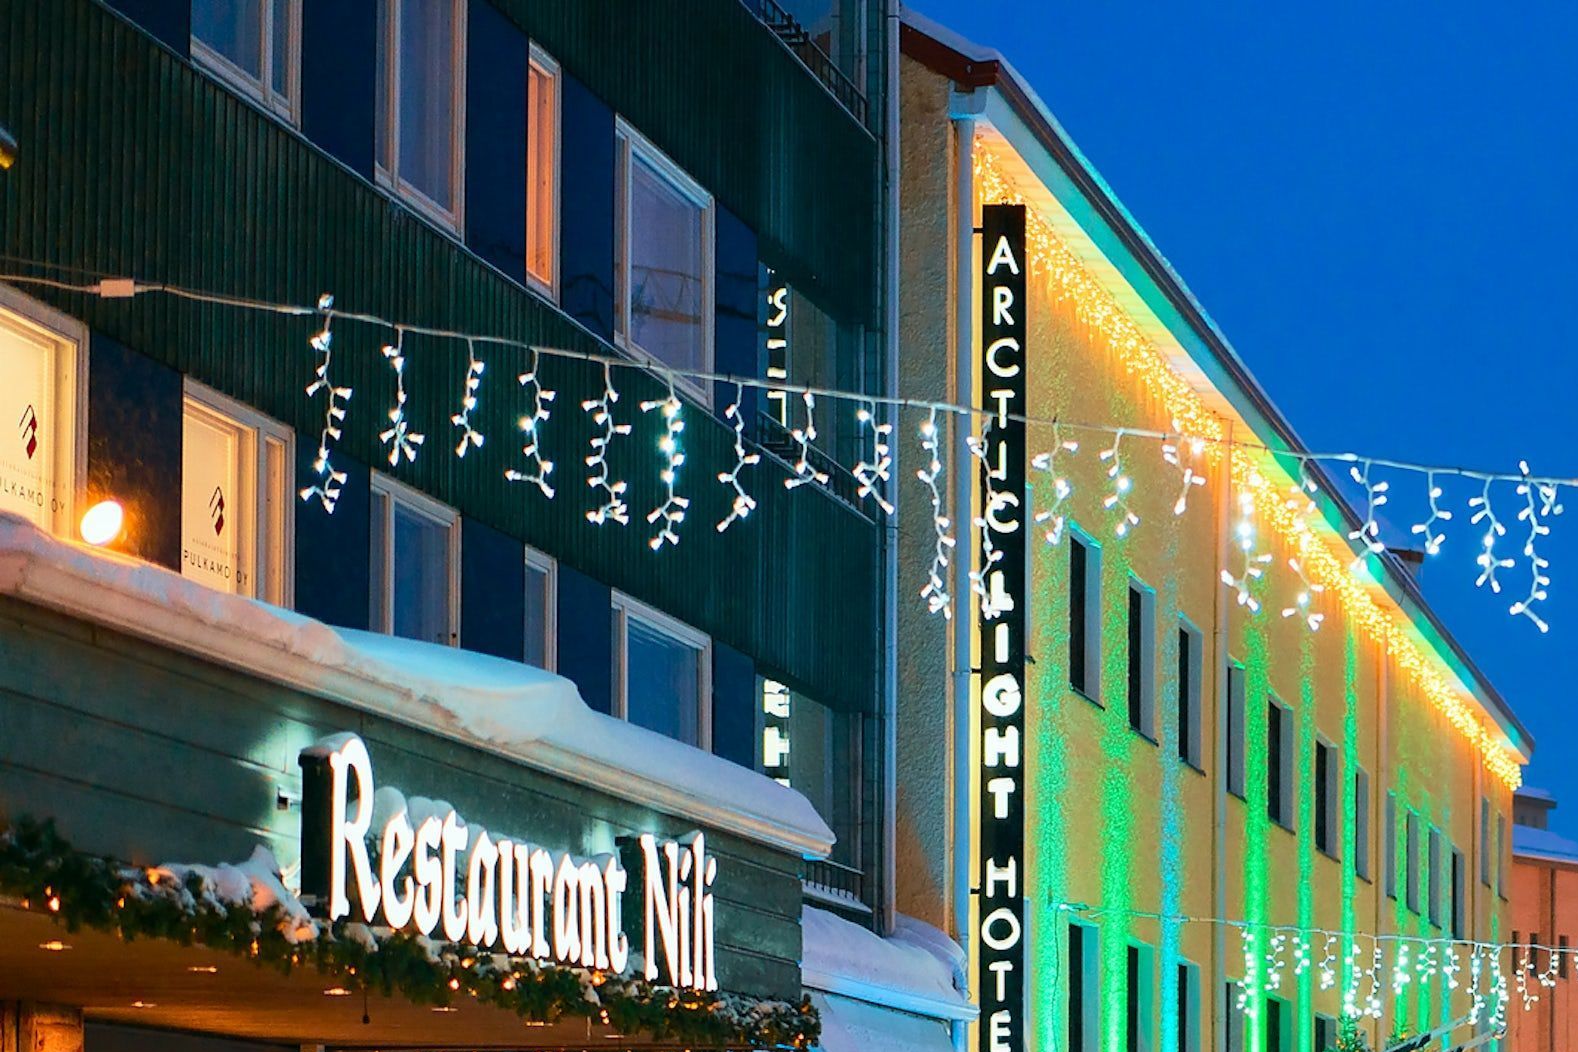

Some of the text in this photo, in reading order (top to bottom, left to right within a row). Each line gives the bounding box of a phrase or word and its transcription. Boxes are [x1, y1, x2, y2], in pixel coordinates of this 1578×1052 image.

[0, 477, 44, 507] LKAMO
[986, 235, 1020, 534] ARCTIC
[183, 549, 248, 585] PULKAMO OY
[983, 570, 1022, 819] LIGHT
[329, 737, 719, 992] Restaurant Nili
